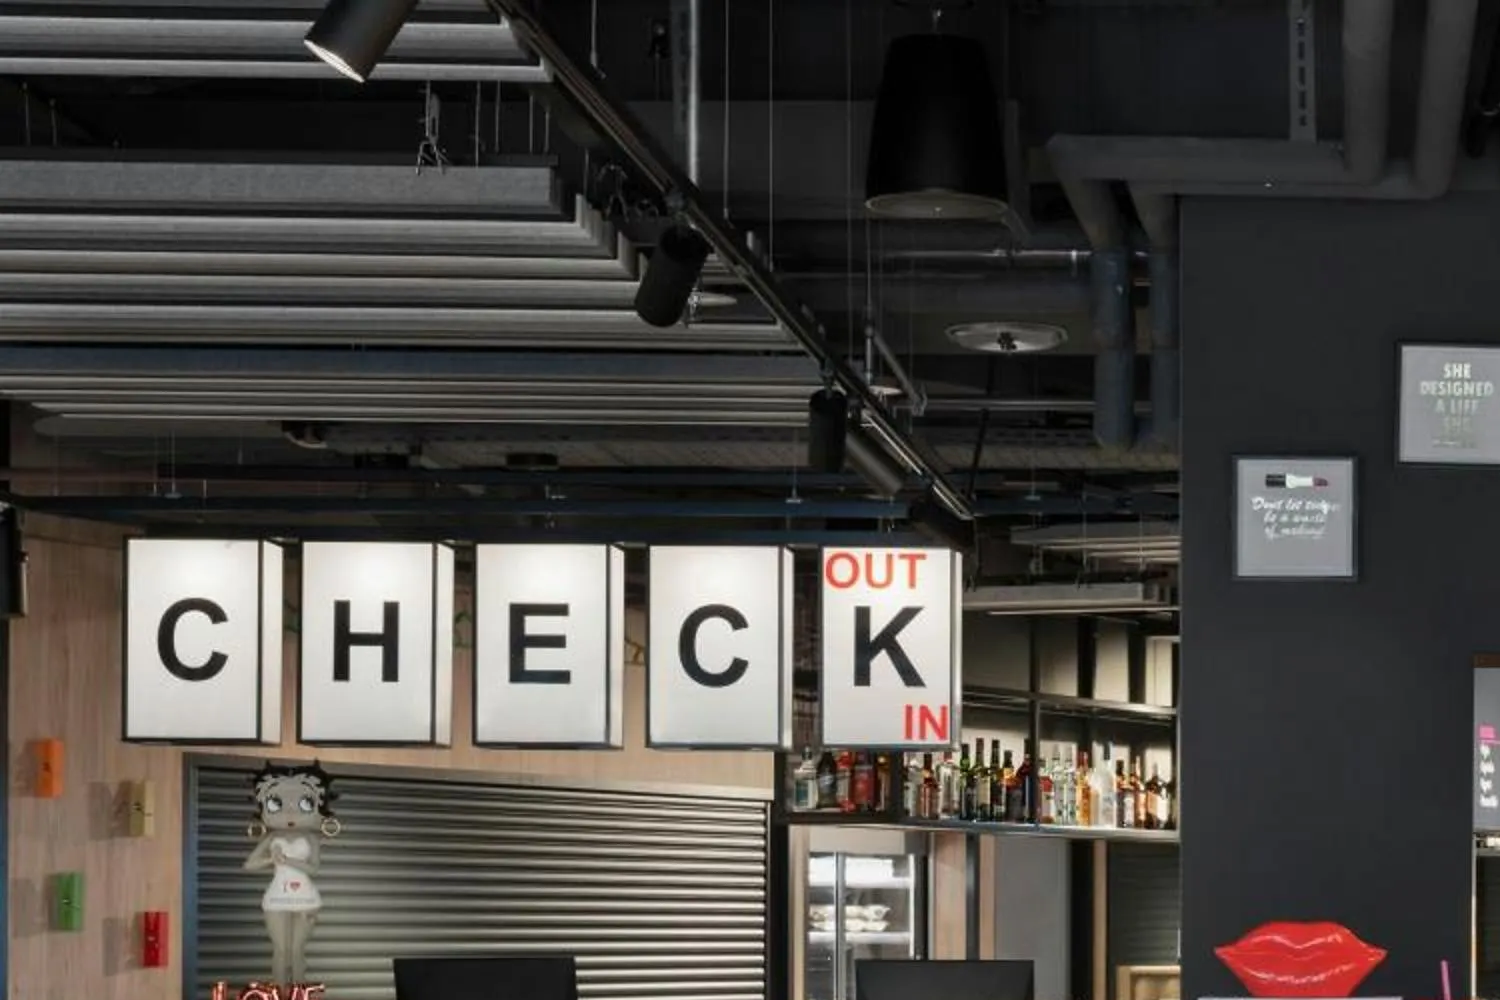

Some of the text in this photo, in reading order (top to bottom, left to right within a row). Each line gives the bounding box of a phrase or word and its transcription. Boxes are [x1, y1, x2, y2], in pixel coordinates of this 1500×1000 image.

[1420, 381, 1494, 397] DESIGNED
[1443, 362, 1471, 379] SHE
[824, 552, 928, 590] OUT
[156, 597, 928, 690] CHECK
[904, 704, 949, 741] IN
